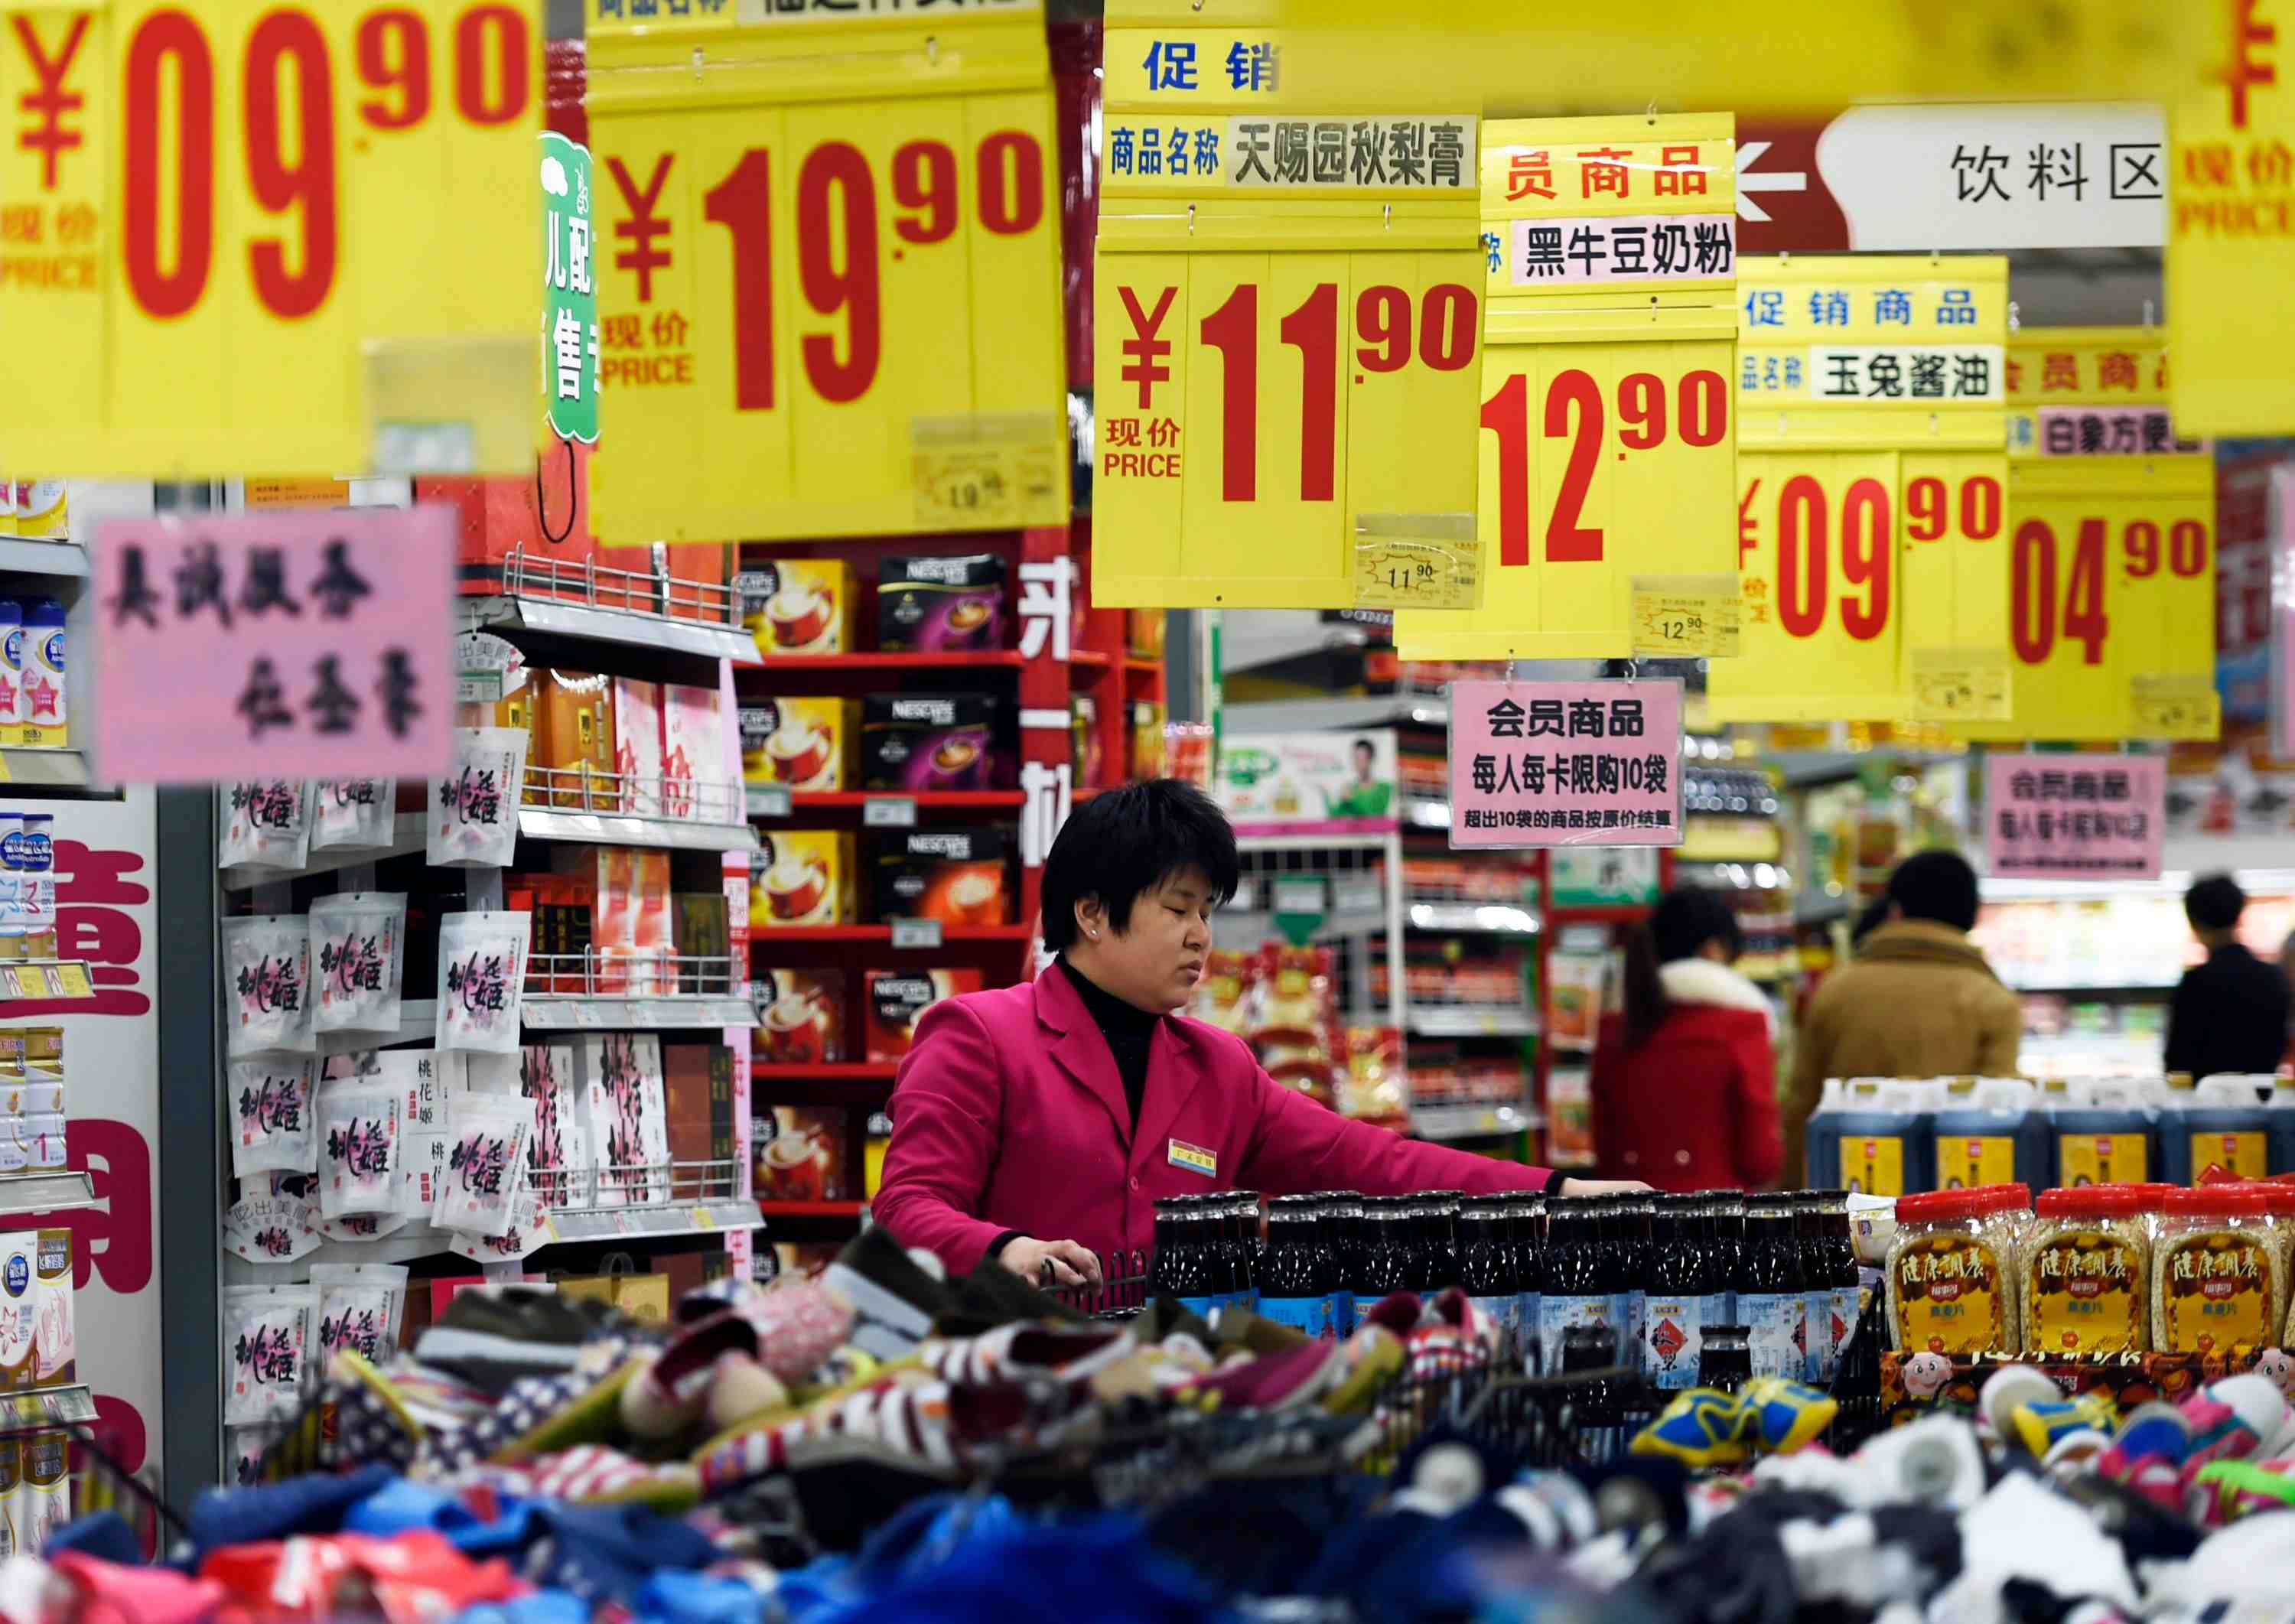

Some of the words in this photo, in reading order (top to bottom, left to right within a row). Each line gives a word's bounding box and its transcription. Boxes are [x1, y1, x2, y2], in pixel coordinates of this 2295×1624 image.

[1111, 127, 1219, 177] 商品名称
[1235, 121, 1465, 187] 天赐园秋梨膏
[1505, 145, 1708, 202] 员商品
[1950, 142, 2164, 203] 饮料区
[1525, 221, 1733, 278] 黑牛豆奶粉
[1744, 288, 1978, 326] 促销商品
[601, 311, 688, 350] 现价
[598, 353, 693, 388] PRICE
[1824, 353, 1990, 399] 玉兔酱油
[1106, 418, 1181, 448] 现价
[2047, 412, 2202, 454] 白象方便
[1103, 453, 1181, 478] PRICE
[1486, 698, 1645, 738] 会员商品
[1472, 752, 1668, 796] 每人每卡限购10袋
[1464, 809, 1672, 829] 超出10袋的商品按原价结算
[418, 1058, 433, 1124] 桃花姬
